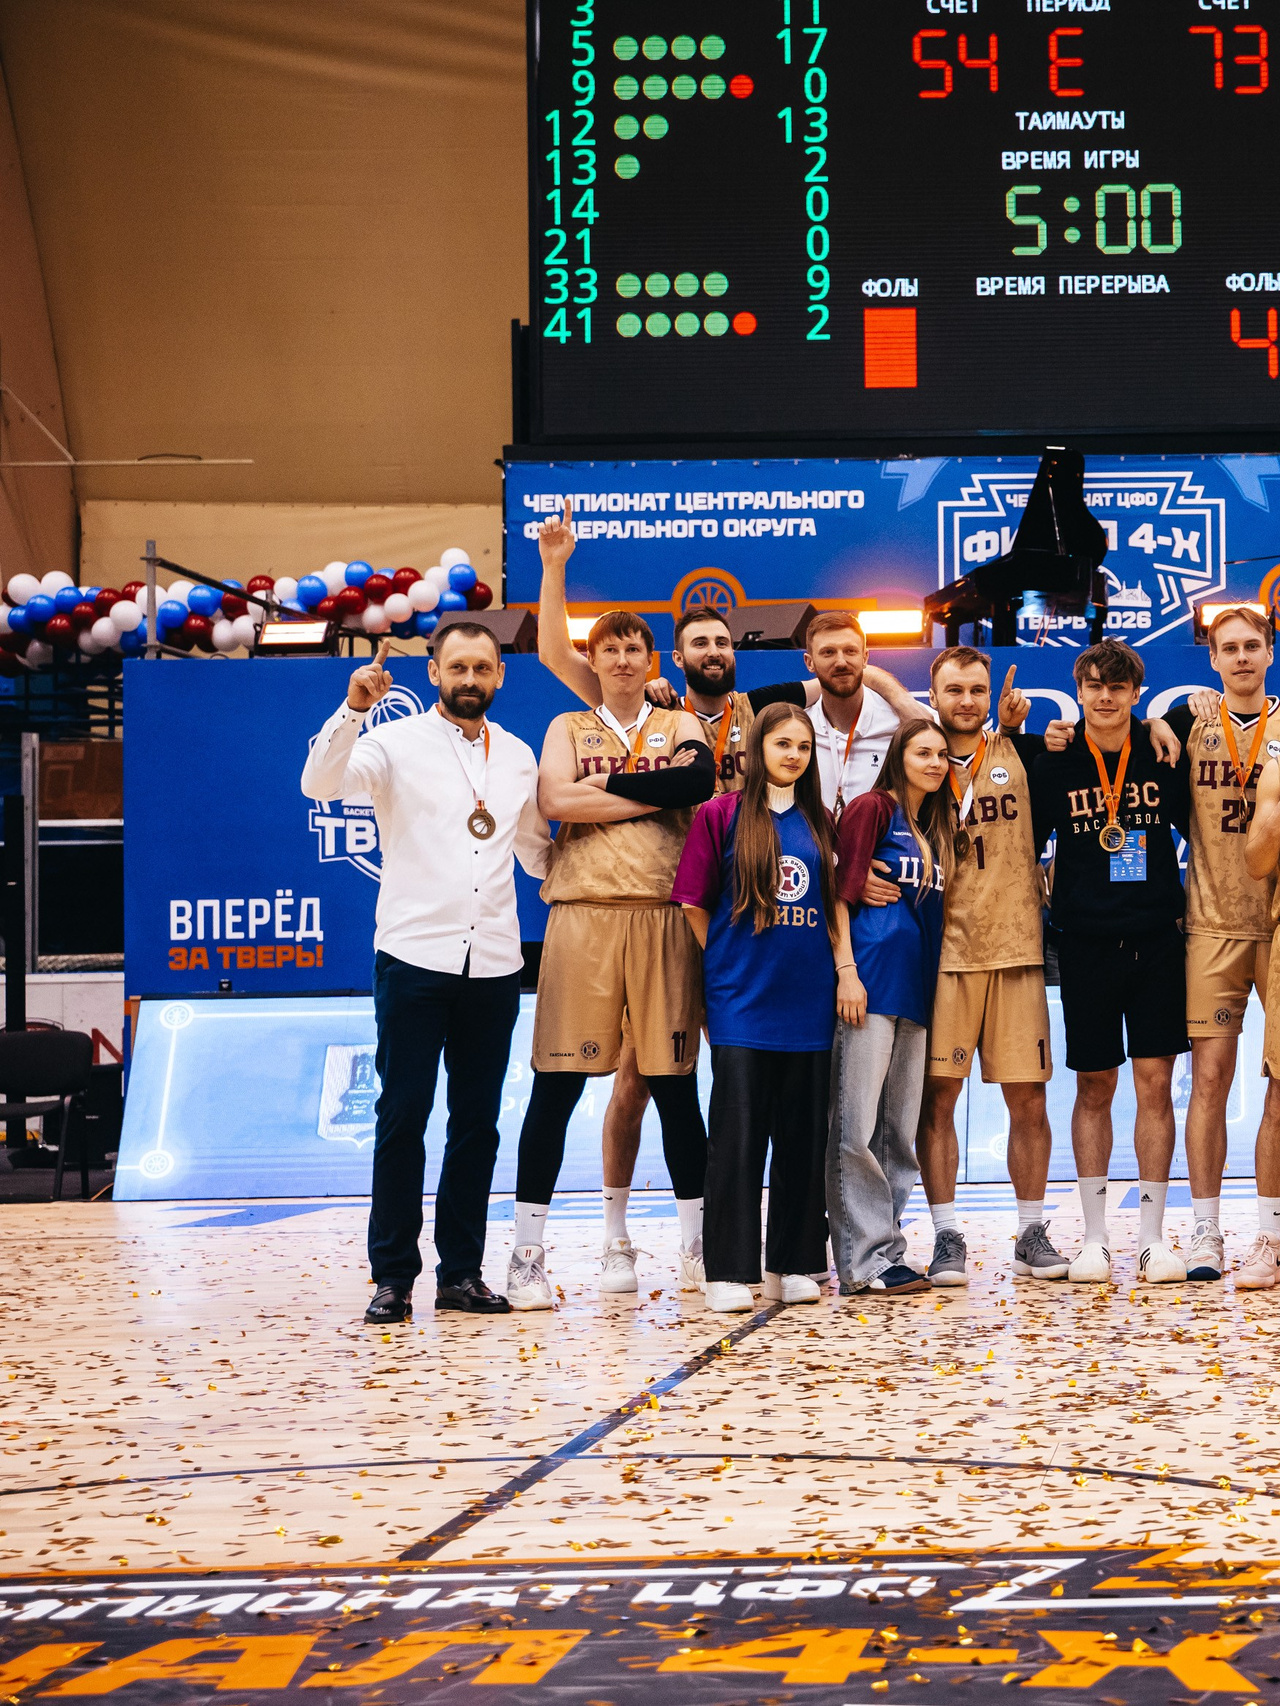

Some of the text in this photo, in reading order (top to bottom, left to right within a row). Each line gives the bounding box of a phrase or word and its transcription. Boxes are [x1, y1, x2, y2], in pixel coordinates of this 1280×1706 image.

[1027, 0, 1110, 12] ПЕРИОД
[572, 30, 594, 66] 5
[777, 28, 827, 64] 17
[1189, 26, 1268, 94] 73
[913, 29, 999, 99] 54
[573, 70, 595, 106] 9
[804, 67, 827, 103] 0
[546, 110, 595, 146] 12
[778, 107, 827, 143] 13
[1015, 111, 1124, 131] ТАЙМАУТЫ
[546, 149, 596, 185] 13
[805, 146, 828, 182] 2
[1002, 149, 1139, 170] ВРЕМЯ ИГРЫ
[547, 189, 599, 225] 14
[806, 186, 829, 221] 0
[1006, 184, 1182, 255] 5:00
[544, 228, 590, 265] 21
[807, 225, 829, 261] 0
[545, 268, 597, 304] 33
[807, 265, 829, 300] 9
[862, 278, 918, 298] ФОЛЫ
[976, 274, 1170, 296] ВРЕМЯ ПЕРЕРЫВА
[544, 308, 591, 343] 41
[807, 304, 830, 340] 2
[1230, 308, 1279, 379] 4
[523, 489, 866, 516] ЧЕМПИОНАТ ЦЕНТРАЛЬНОГО
[1006, 492, 1158, 509] ЧЕНАТ ЦФО
[523, 517, 817, 542] ФДЕРАЛЬНОГО ОКРУГА
[963, 520, 1201, 563] ФИЛ 4-Х
[1102, 611, 1152, 630] 026
[719, 750, 747, 780] ВС
[1197, 760, 1264, 790] ЦИВ
[951, 793, 1018, 829] ИВС
[1072, 813, 1161, 834] БАСЕТБОЛ
[973, 835, 985, 870] 1
[169, 888, 324, 942] ВПЕРЁД
[774, 905, 819, 928] ИВС
[168, 944, 324, 971] ЗА ТВЕРЬ!
[671, 1031, 688, 1063] 11
[1037, 1038, 1046, 1070] 1
[630, 1573, 939, 1606] ЦФО
